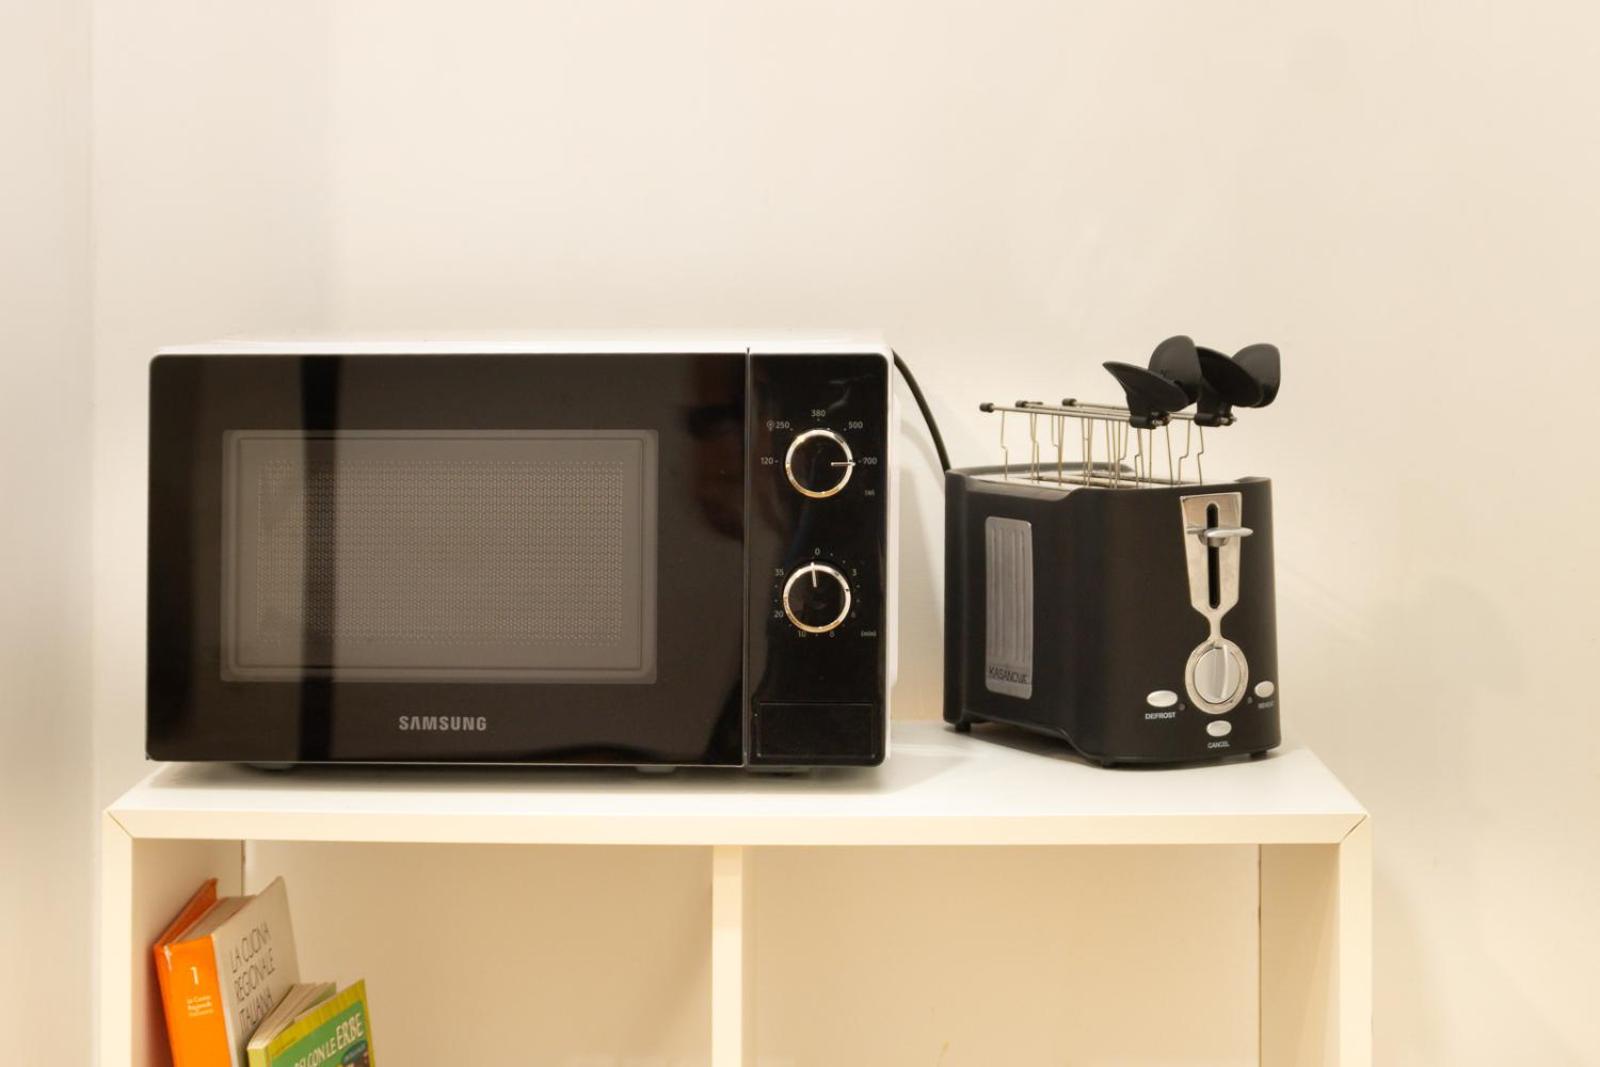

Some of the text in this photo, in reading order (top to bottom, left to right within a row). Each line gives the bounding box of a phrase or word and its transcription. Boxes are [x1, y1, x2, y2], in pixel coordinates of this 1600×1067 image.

[811, 409, 826, 417] 380
[775, 421, 790, 429] 250
[848, 421, 863, 429] 500
[761, 457, 774, 465] 120
[862, 457, 877, 465] 700
[814, 547, 821, 556] 0
[775, 568, 784, 576] 35
[852, 568, 857, 577] 3
[774, 610, 784, 618] 20
[1144, 711, 1176, 720] DEFROST
[398, 715, 487, 731] SAMSUNG
[1207, 740, 1230, 749] CANCEL
[190, 966, 200, 985] 1
[336, 1012, 365, 1051] ERBE
